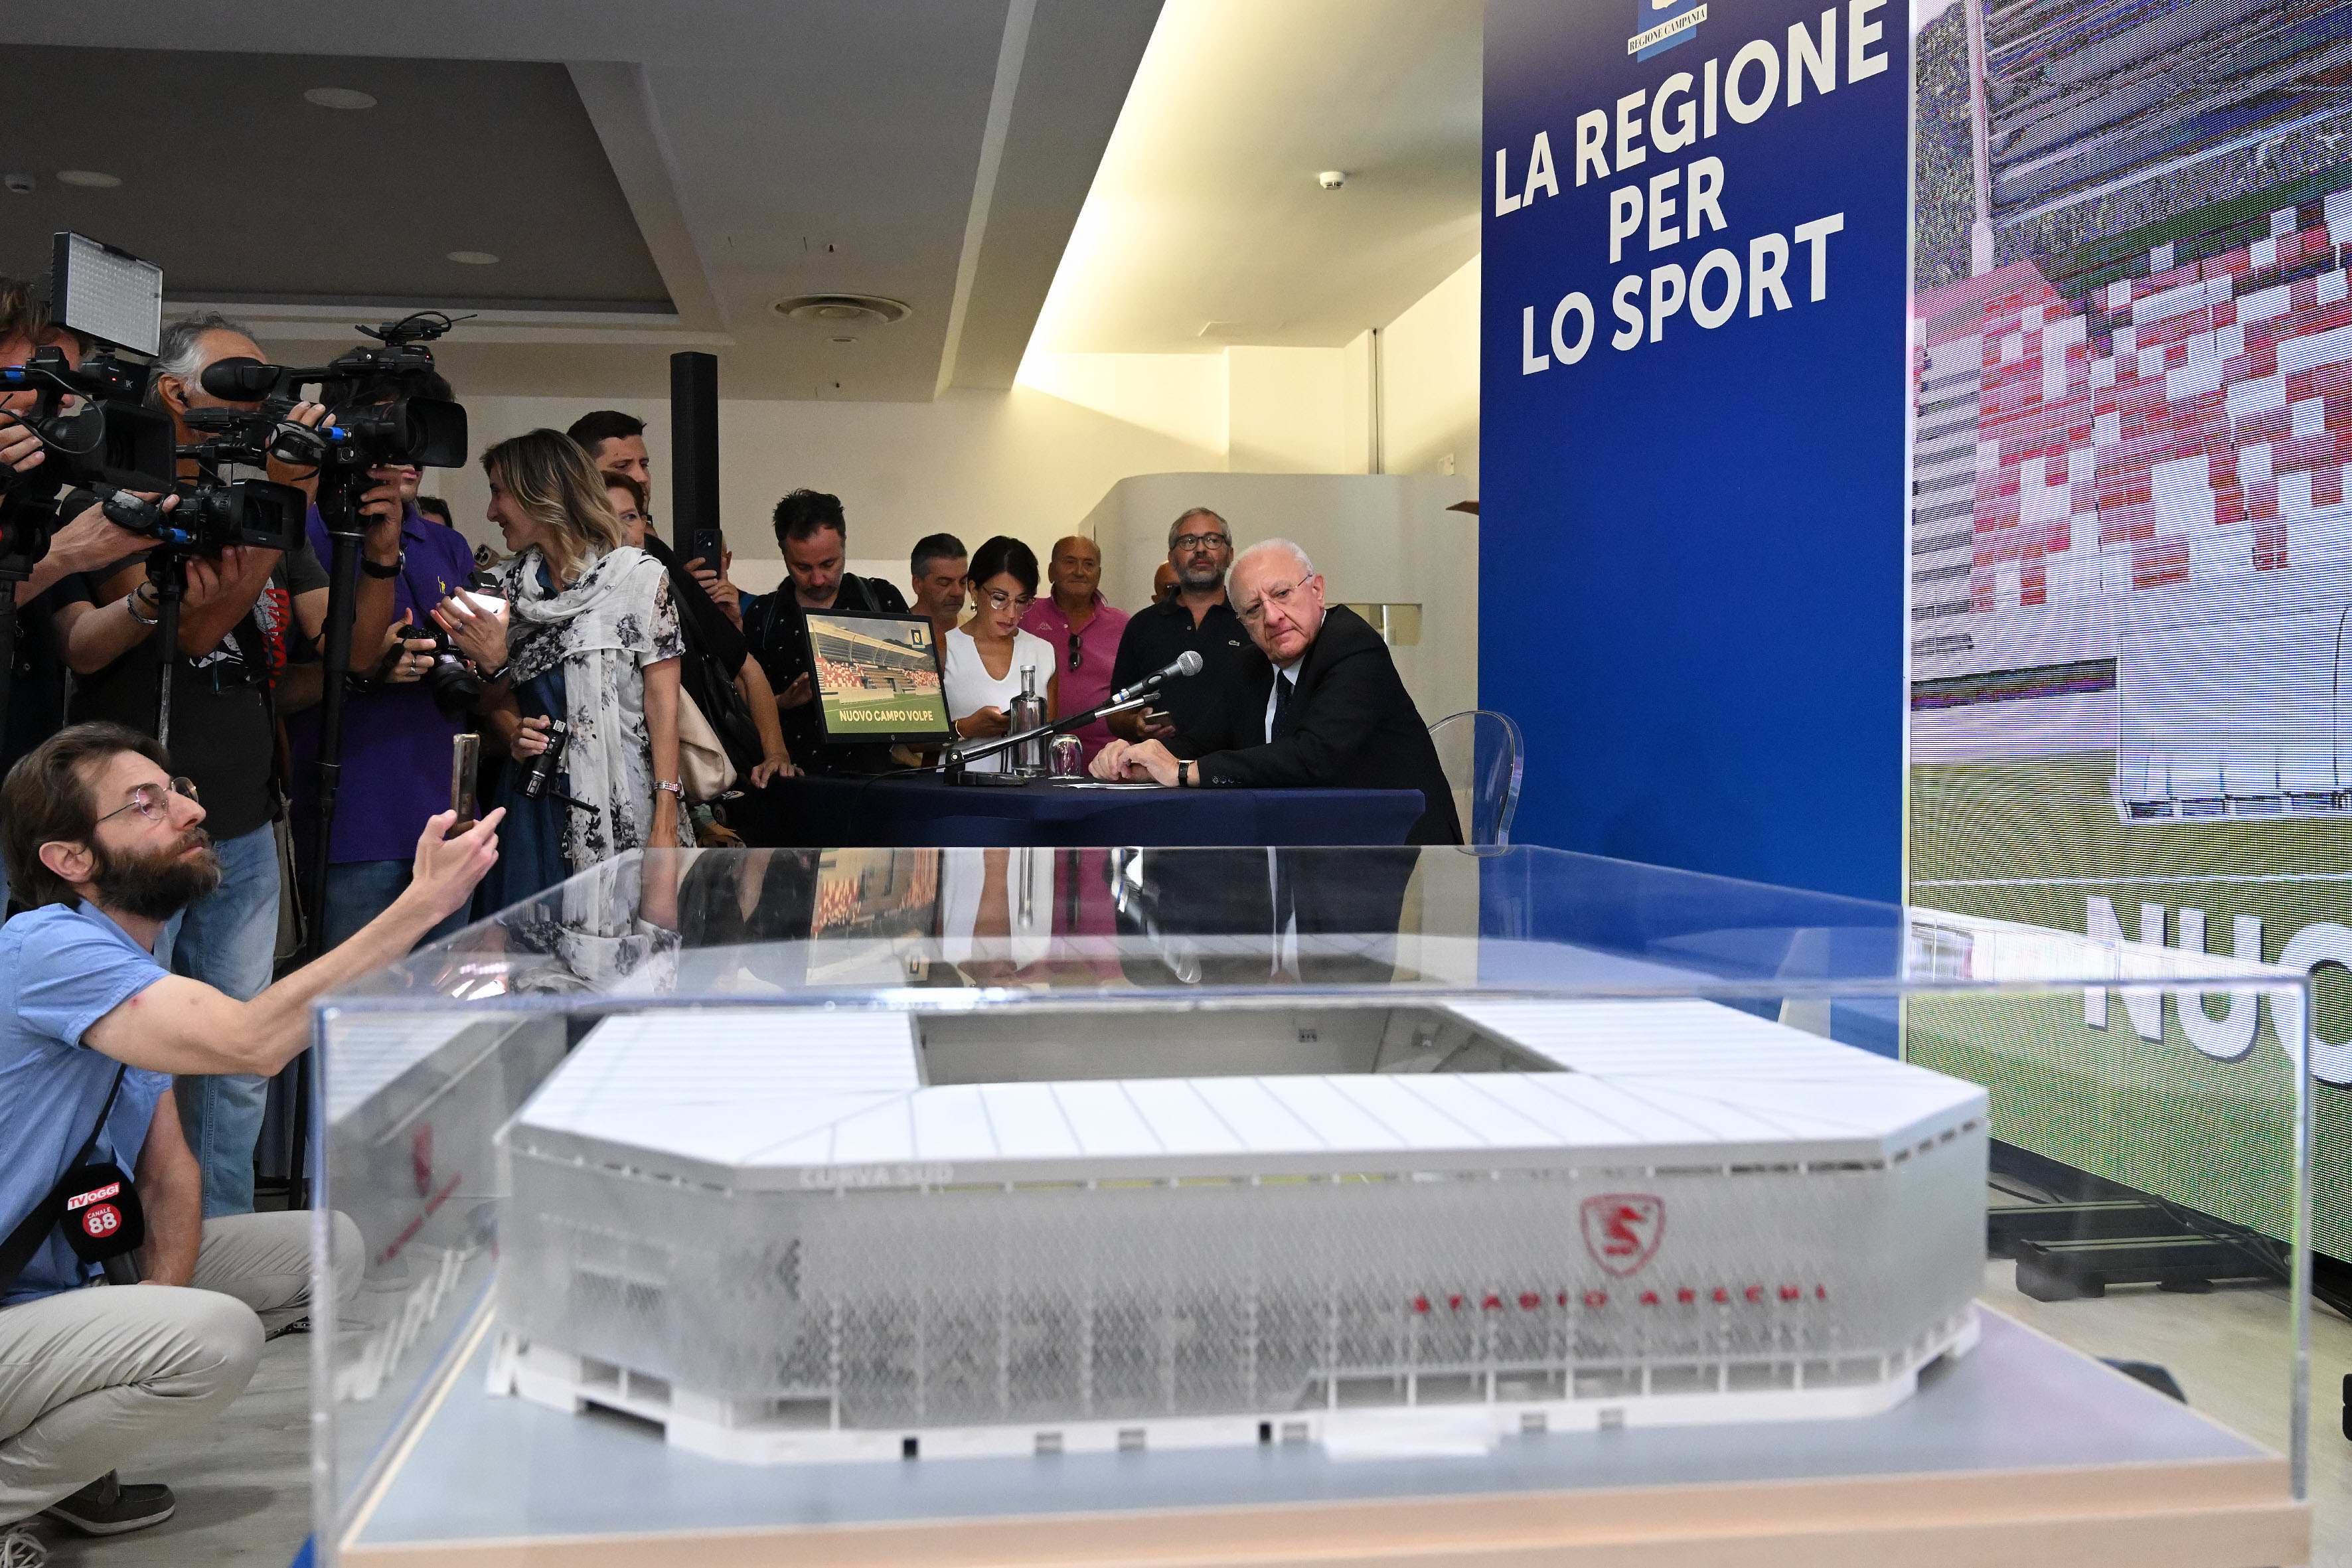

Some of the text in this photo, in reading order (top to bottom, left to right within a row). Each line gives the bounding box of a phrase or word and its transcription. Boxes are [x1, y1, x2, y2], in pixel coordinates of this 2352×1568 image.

[1630, 9, 1705, 51] REGIONE CAMPANIA
[1496, 0, 1888, 218] LA REGIONE
[1610, 156, 1727, 264] PER
[1523, 212, 1844, 376] LO SPORT
[839, 710, 934, 722] NUOVO CAMPO VOLPE
[87, 1206, 112, 1219] CANALE
[88, 1212, 118, 1234] 88
